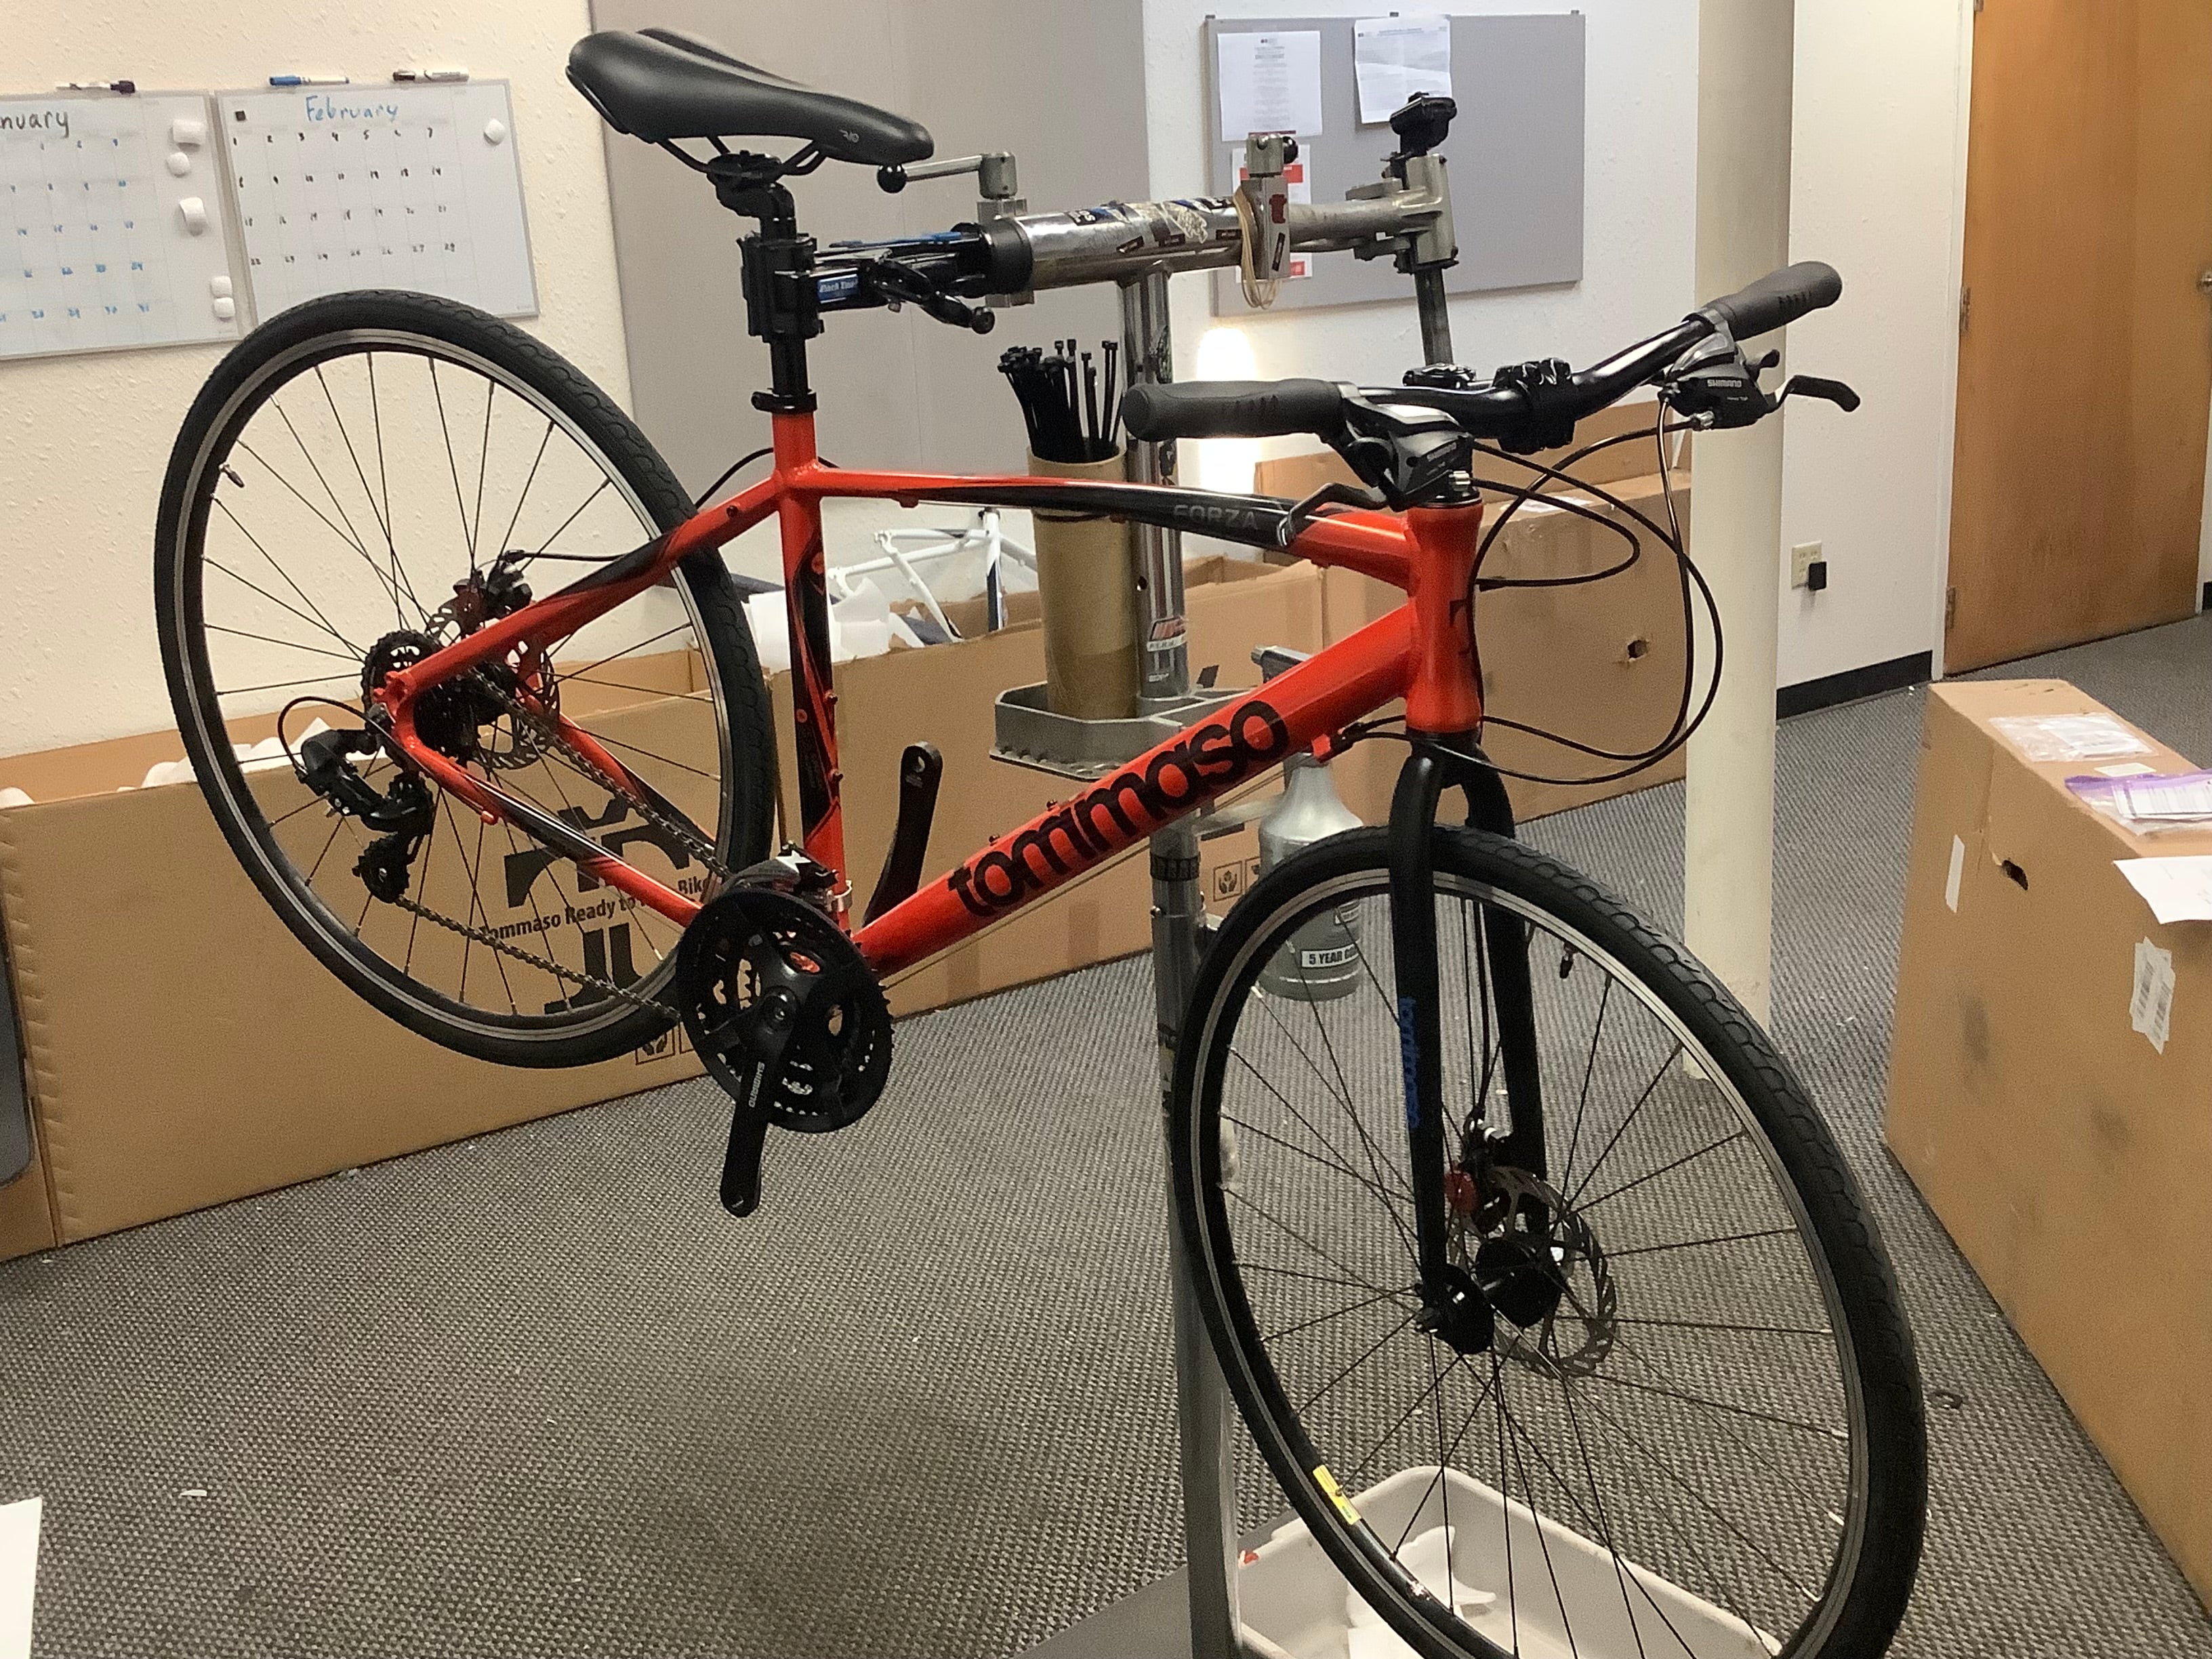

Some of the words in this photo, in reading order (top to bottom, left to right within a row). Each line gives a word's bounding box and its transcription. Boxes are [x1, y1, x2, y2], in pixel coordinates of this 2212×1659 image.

[306, 95, 398, 123] February
[0, 110, 70, 138] nuary
[1707, 379, 1742, 388] SHIMANO
[1173, 504, 1258, 530] FORZA
[947, 700, 1289, 918] tommaso
[564, 898, 616, 925] Ready
[618, 896, 636, 912] to
[1309, 954, 1317, 965] 5
[1319, 951, 1343, 964] YEAR
[748, 1061, 765, 1108] SHIMANO
